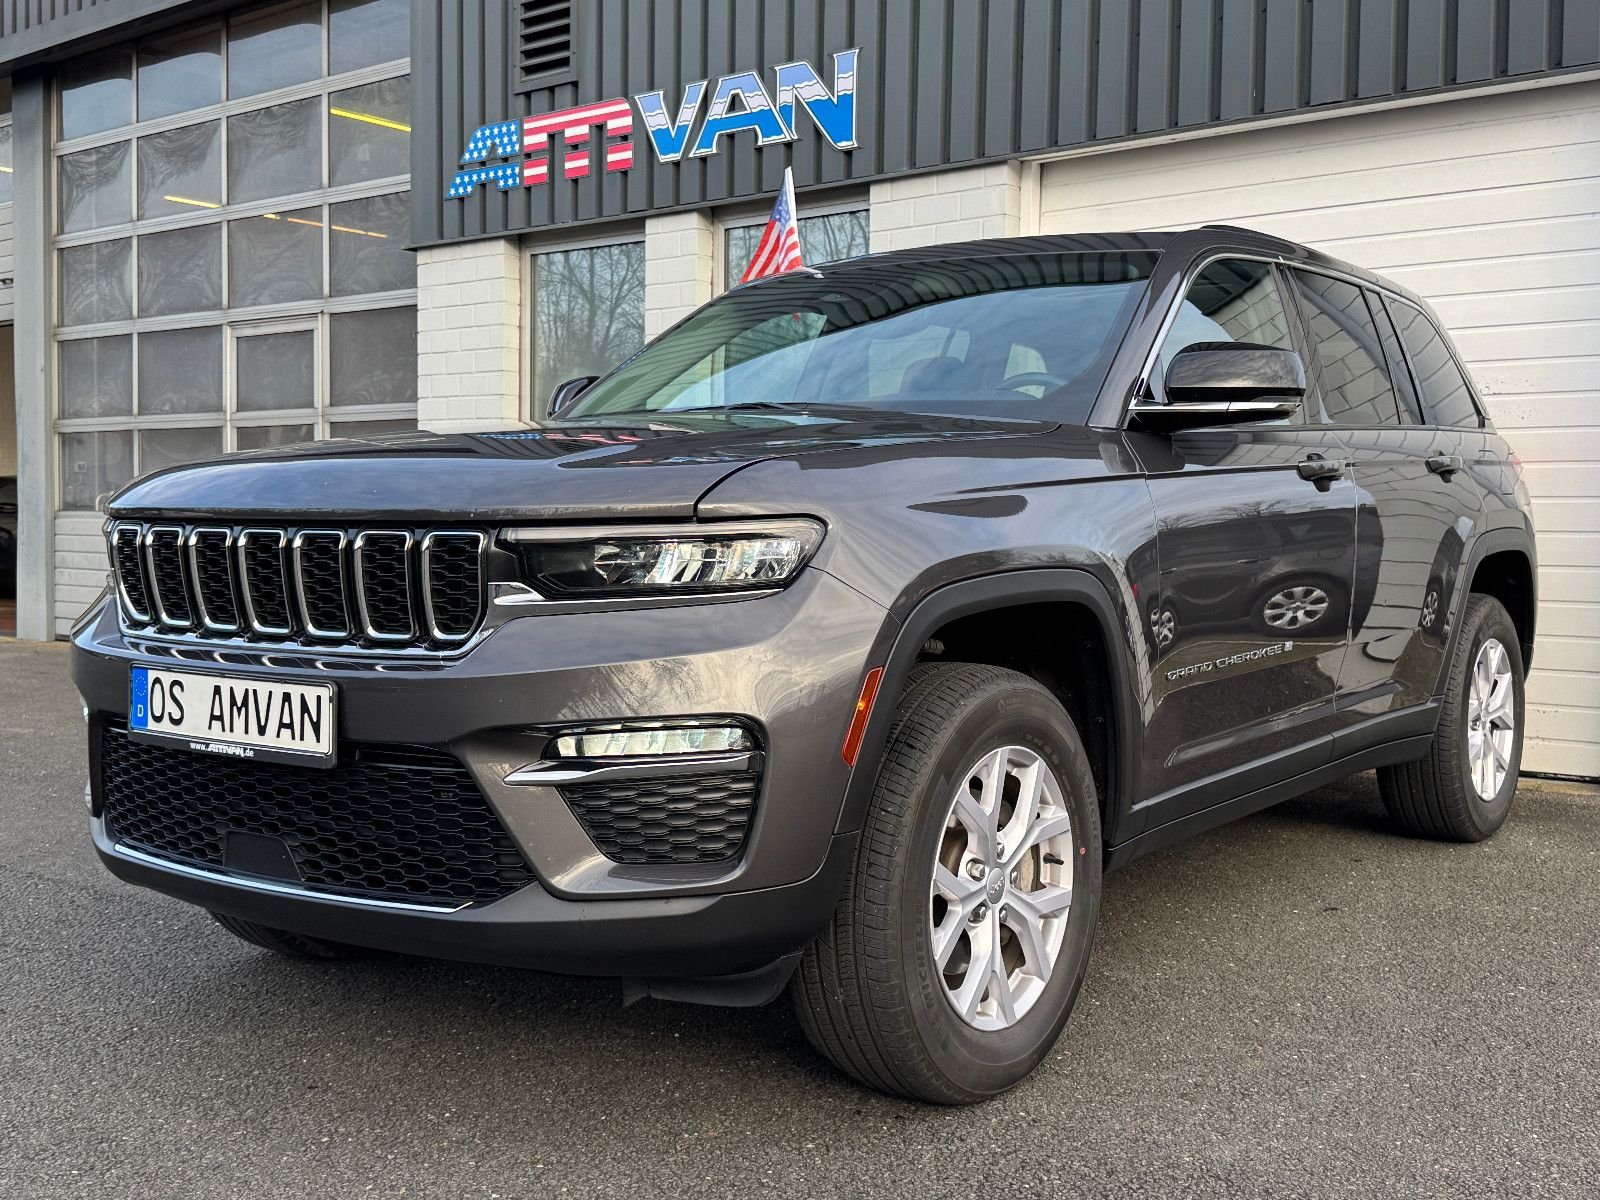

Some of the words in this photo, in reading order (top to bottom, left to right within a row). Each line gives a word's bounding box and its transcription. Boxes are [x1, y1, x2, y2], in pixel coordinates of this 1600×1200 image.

[1166, 661, 1212, 680] GRAND
[1215, 644, 1283, 669] CHEROKEE
[137, 704, 144, 717] D
[150, 676, 184, 726] OS
[208, 684, 321, 744] AMVAN
